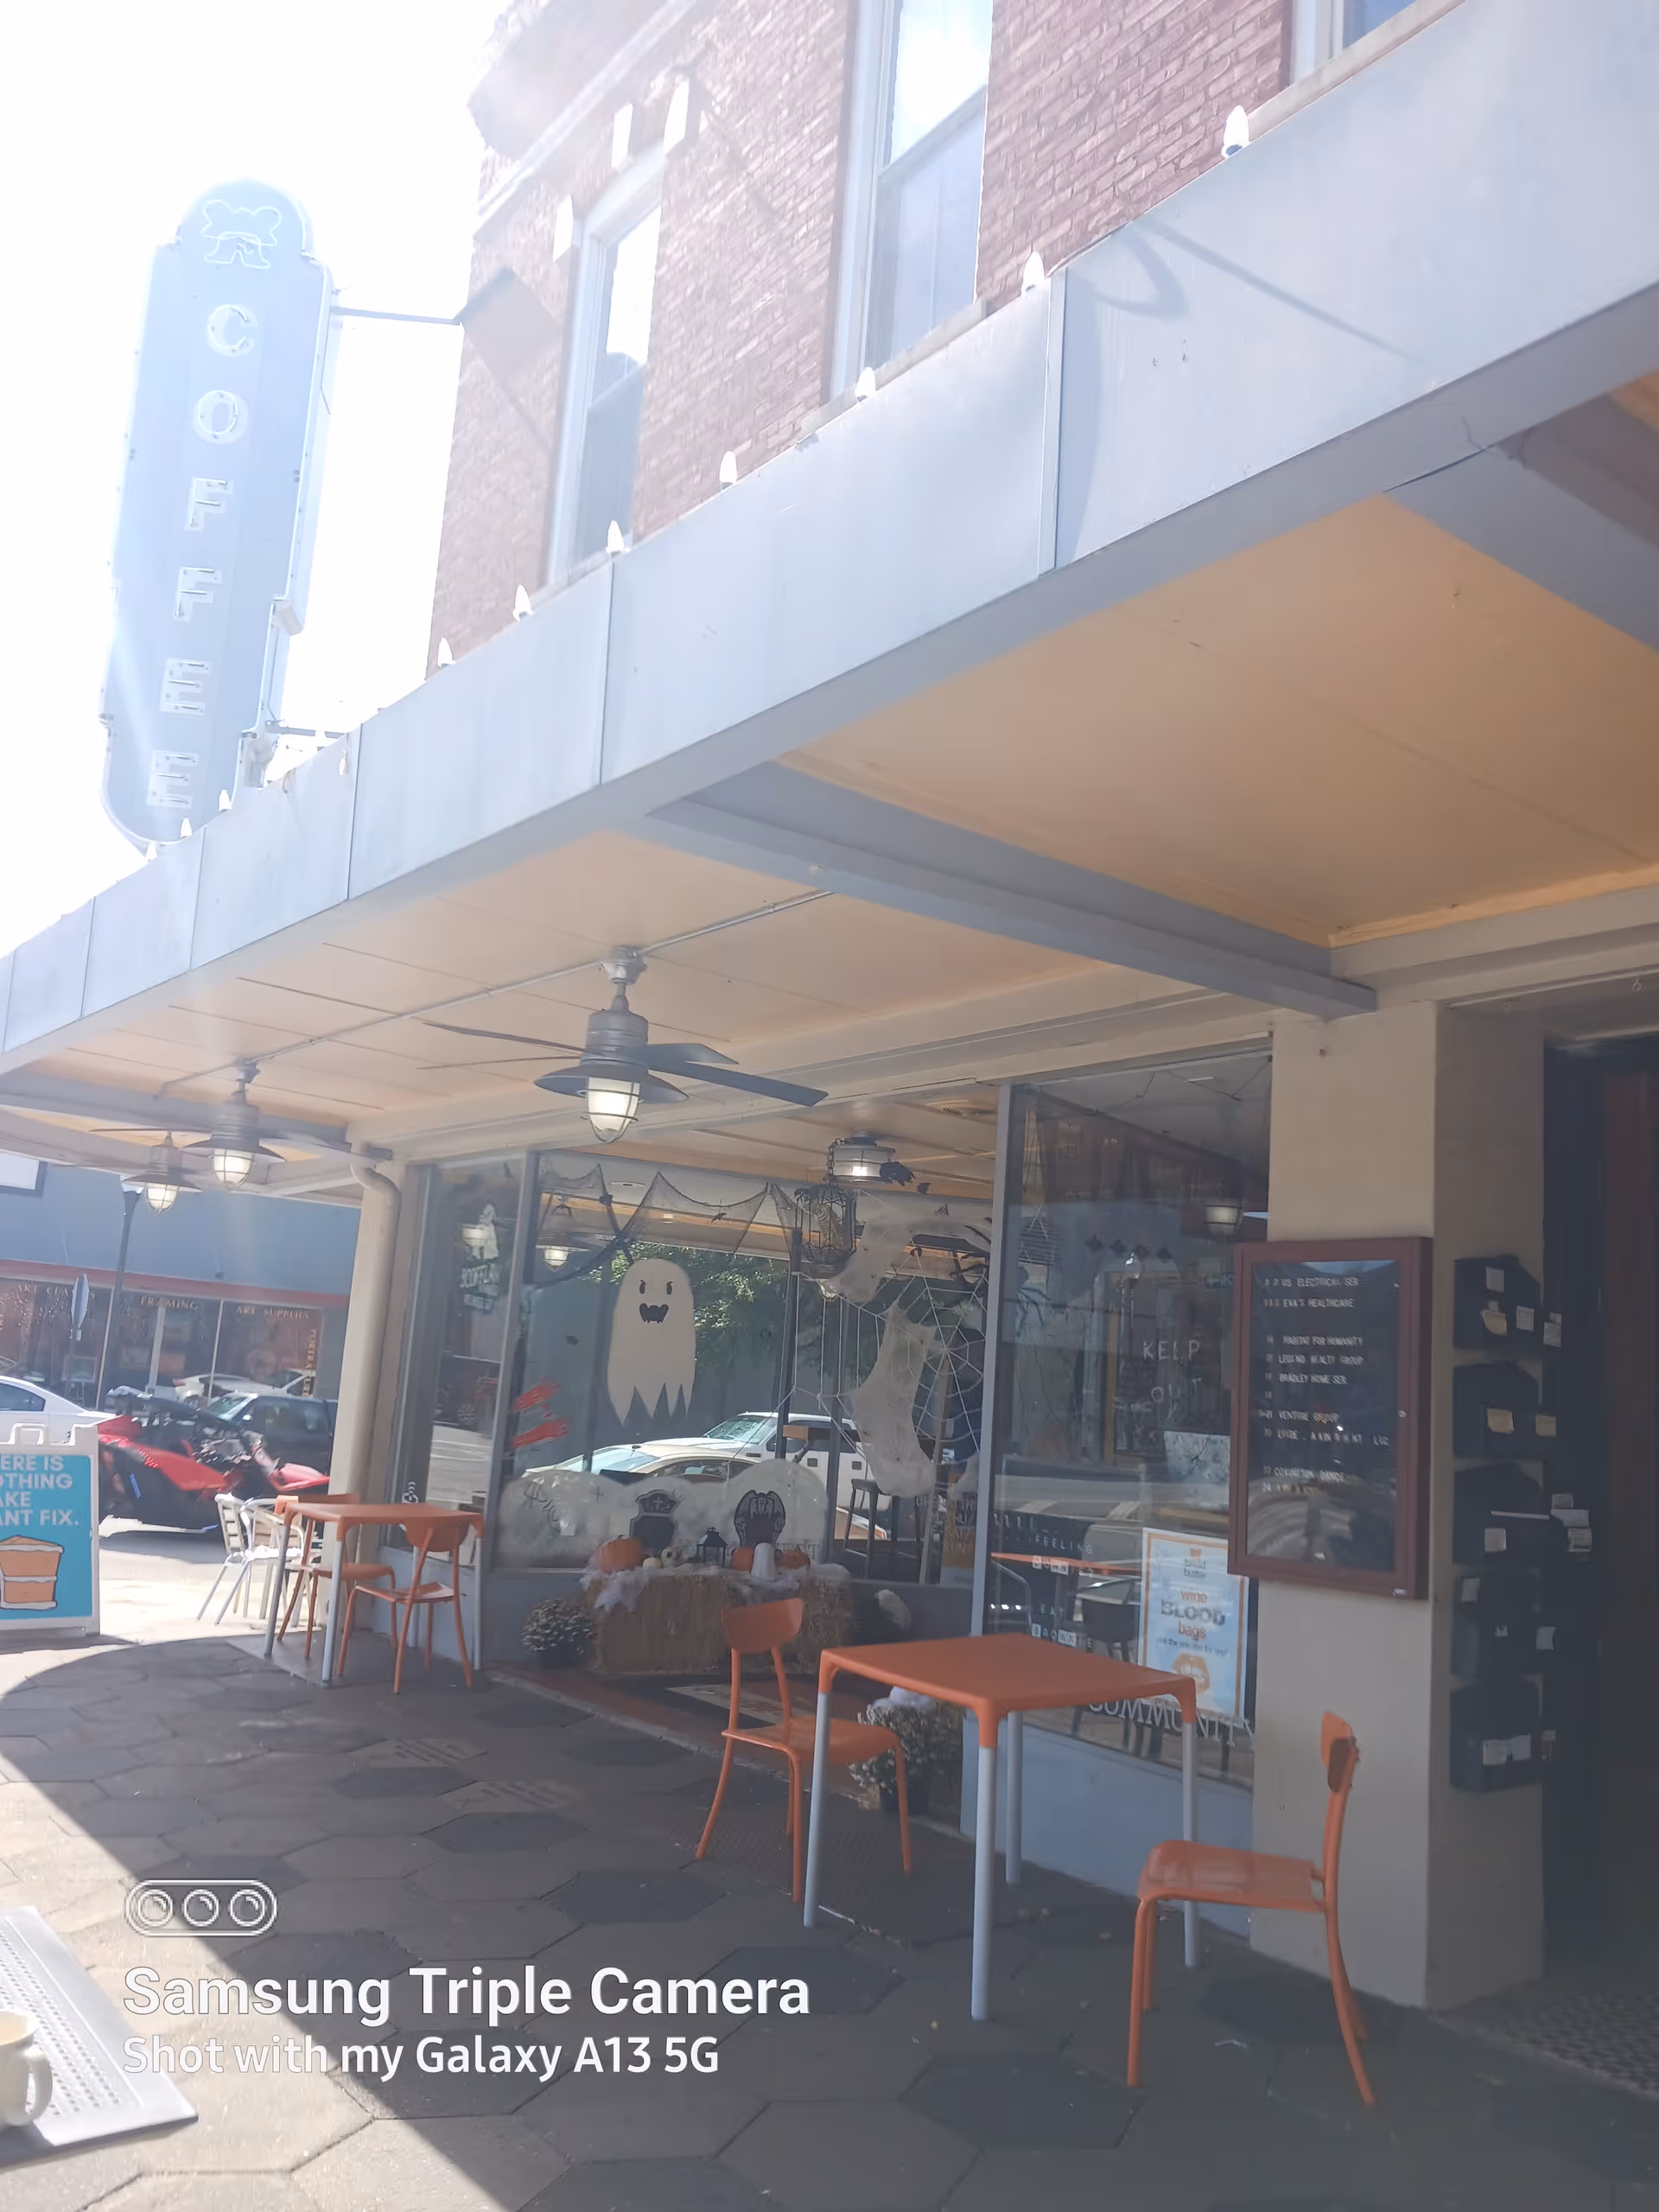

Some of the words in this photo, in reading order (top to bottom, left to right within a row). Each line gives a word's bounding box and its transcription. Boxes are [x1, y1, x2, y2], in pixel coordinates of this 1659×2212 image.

[147, 303, 258, 810] COFFEE
[140, 1295, 200, 1311] FRAMING
[235, 1305, 257, 1315] ART
[264, 1307, 310, 1320] SUPPLIES
[44, 1455, 64, 1471] IS
[40, 1510, 79, 1526] FIX.
[1180, 1587, 1207, 1605] wine
[1160, 1599, 1225, 1626] BLOOD
[1178, 1620, 1207, 1642] bags
